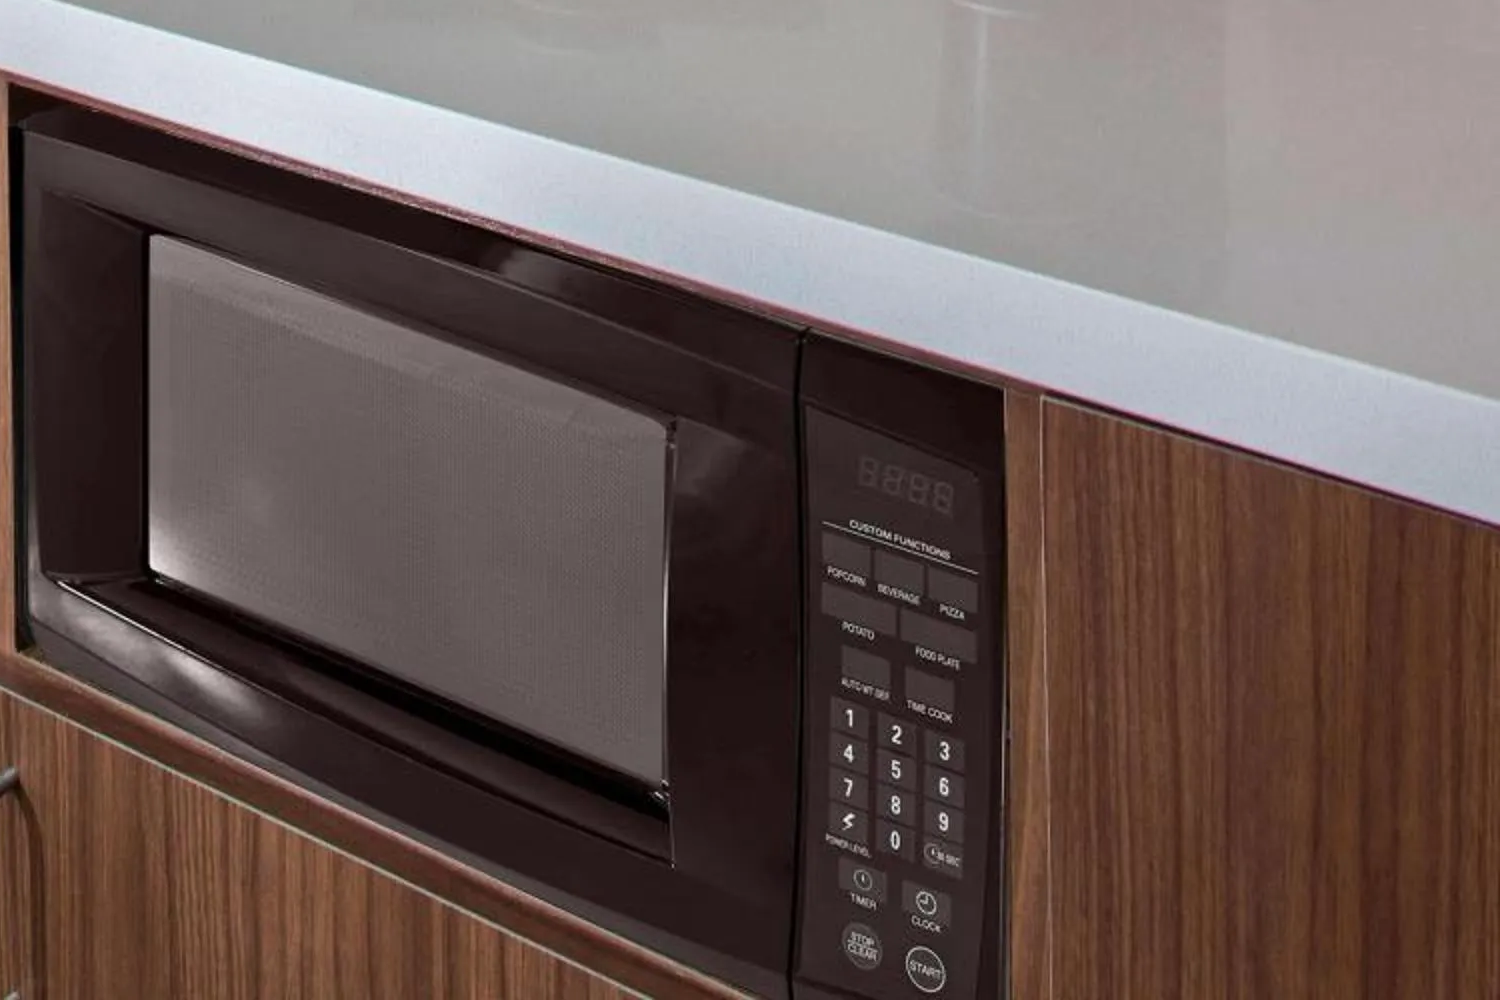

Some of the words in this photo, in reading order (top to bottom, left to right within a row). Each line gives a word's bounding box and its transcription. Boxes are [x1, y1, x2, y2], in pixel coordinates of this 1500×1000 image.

[849, 519, 892, 542] CUSTOM
[893, 533, 951, 561] FUNCTIONS
[827, 565, 867, 587] POPCORN
[877, 583, 921, 606] BEVERAGE
[939, 603, 965, 621] PIZZA
[841, 621, 875, 641] POTATO
[845, 708, 854, 728] 1
[907, 699, 927, 715] TIME
[927, 707, 953, 724] COOK
[891, 725, 902, 745] 2
[843, 744, 854, 763] 4
[939, 741, 951, 761] 3
[891, 760, 901, 779] 5
[843, 778, 853, 797] 7
[939, 777, 949, 797] 6
[891, 795, 901, 815] 8
[939, 812, 949, 832] 9
[890, 830, 901, 850] 0
[851, 893, 877, 910] TIMER
[911, 915, 941, 933] CLOCK
[850, 931, 875, 946] STOP
[909, 959, 941, 979] START
